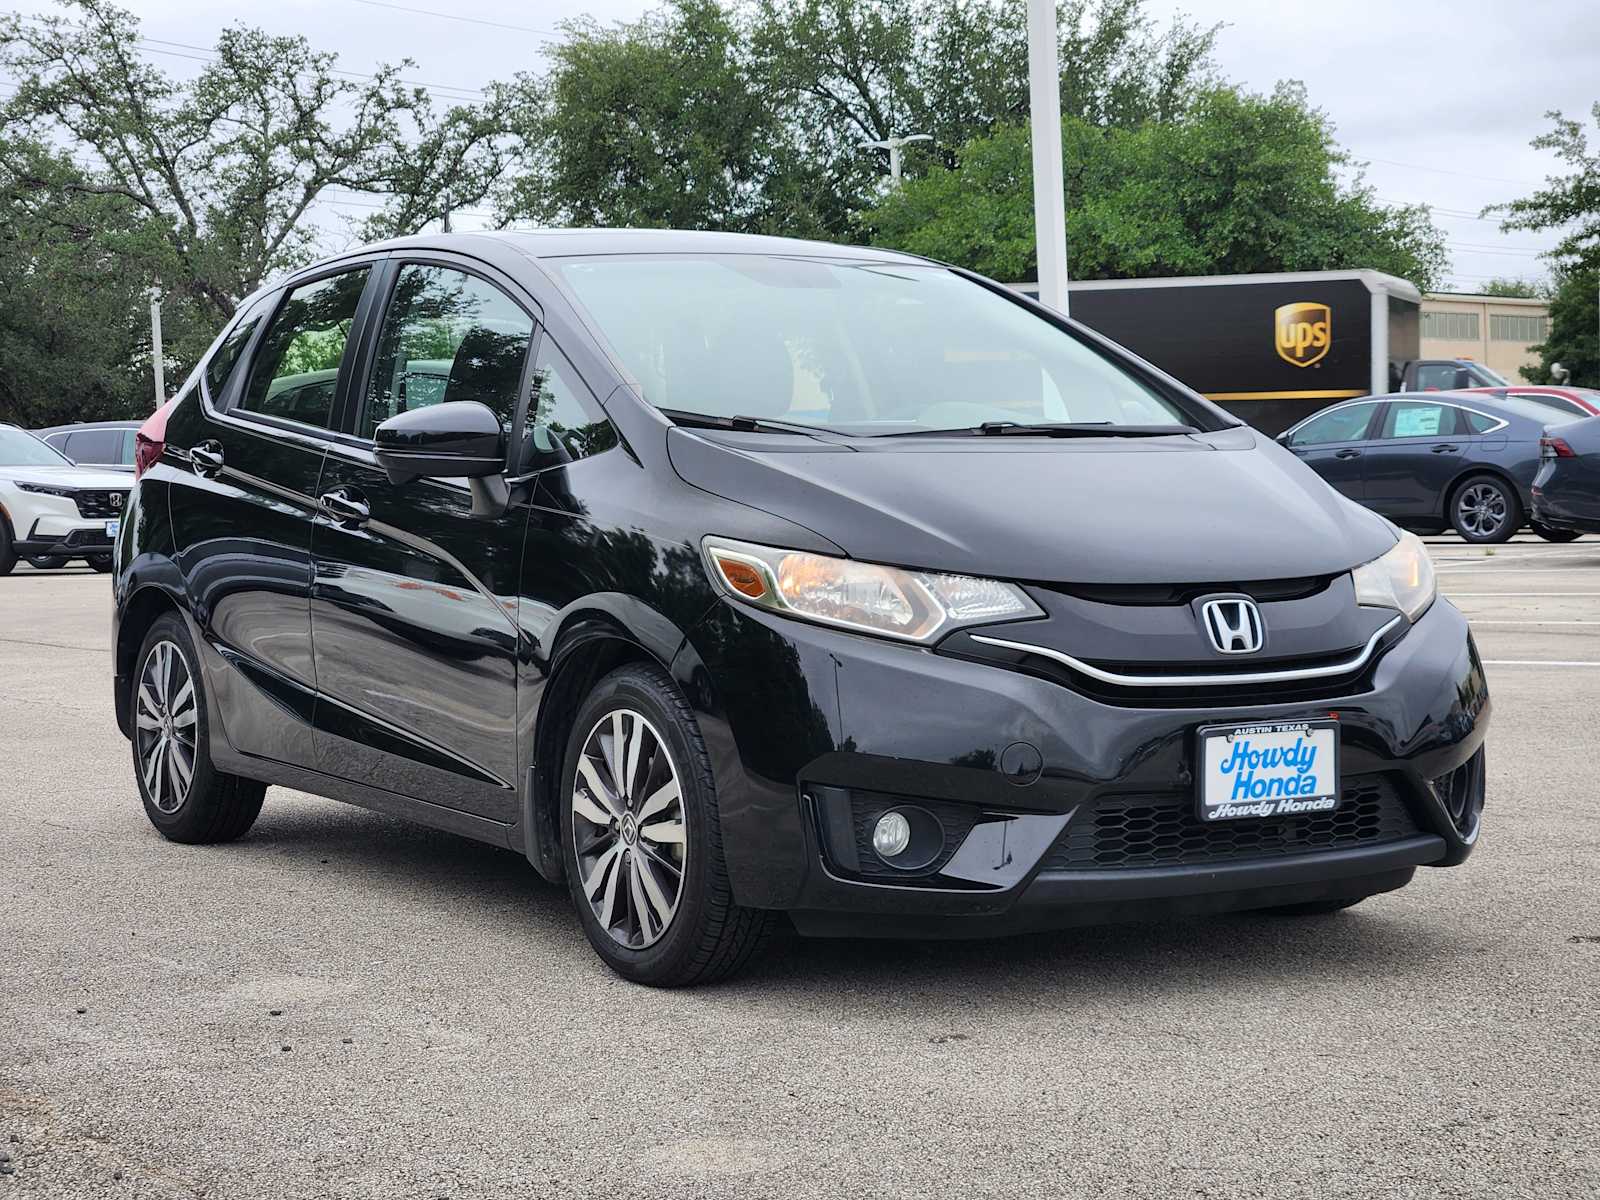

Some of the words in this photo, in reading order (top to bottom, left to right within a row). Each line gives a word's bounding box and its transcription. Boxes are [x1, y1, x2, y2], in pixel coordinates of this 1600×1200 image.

[1280, 321, 1327, 358] ups
[1234, 725, 1272, 735] AUSTIN
[1275, 723, 1310, 732] TEXAS
[1220, 737, 1318, 774] Howdy
[1231, 770, 1318, 800] Honda
[1208, 800, 1275, 819] Howdy
[1276, 796, 1335, 813] Honda
